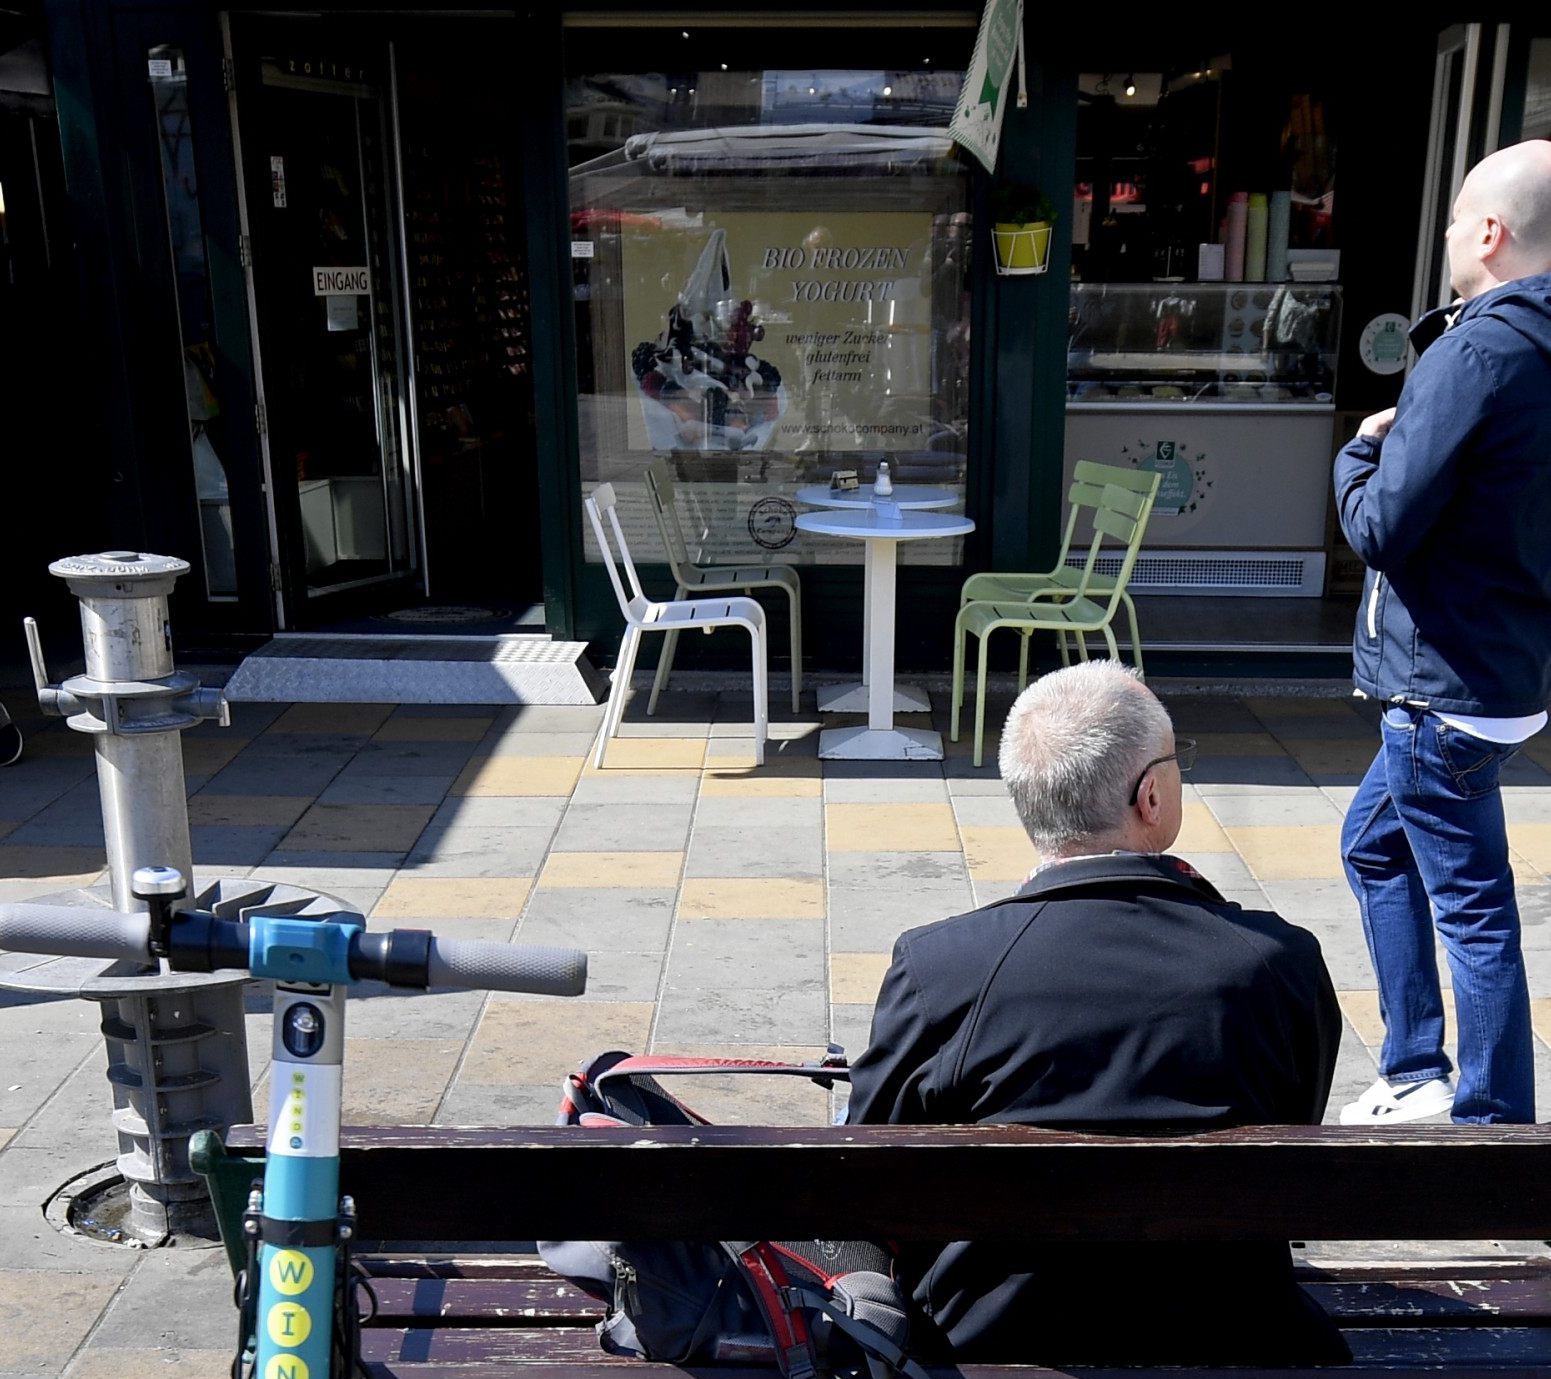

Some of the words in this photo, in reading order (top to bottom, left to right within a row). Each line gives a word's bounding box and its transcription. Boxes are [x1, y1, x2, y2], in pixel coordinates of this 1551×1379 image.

[763, 247, 806, 269] BIO
[812, 247, 910, 269] FROZEN
[317, 271, 368, 291] EINGANG
[793, 280, 894, 301] YOGURT
[786, 331, 840, 347] weniger
[806, 350, 871, 366] glutenfrei
[812, 368, 861, 385] fettarm
[292, 1072, 306, 1132] WIND
